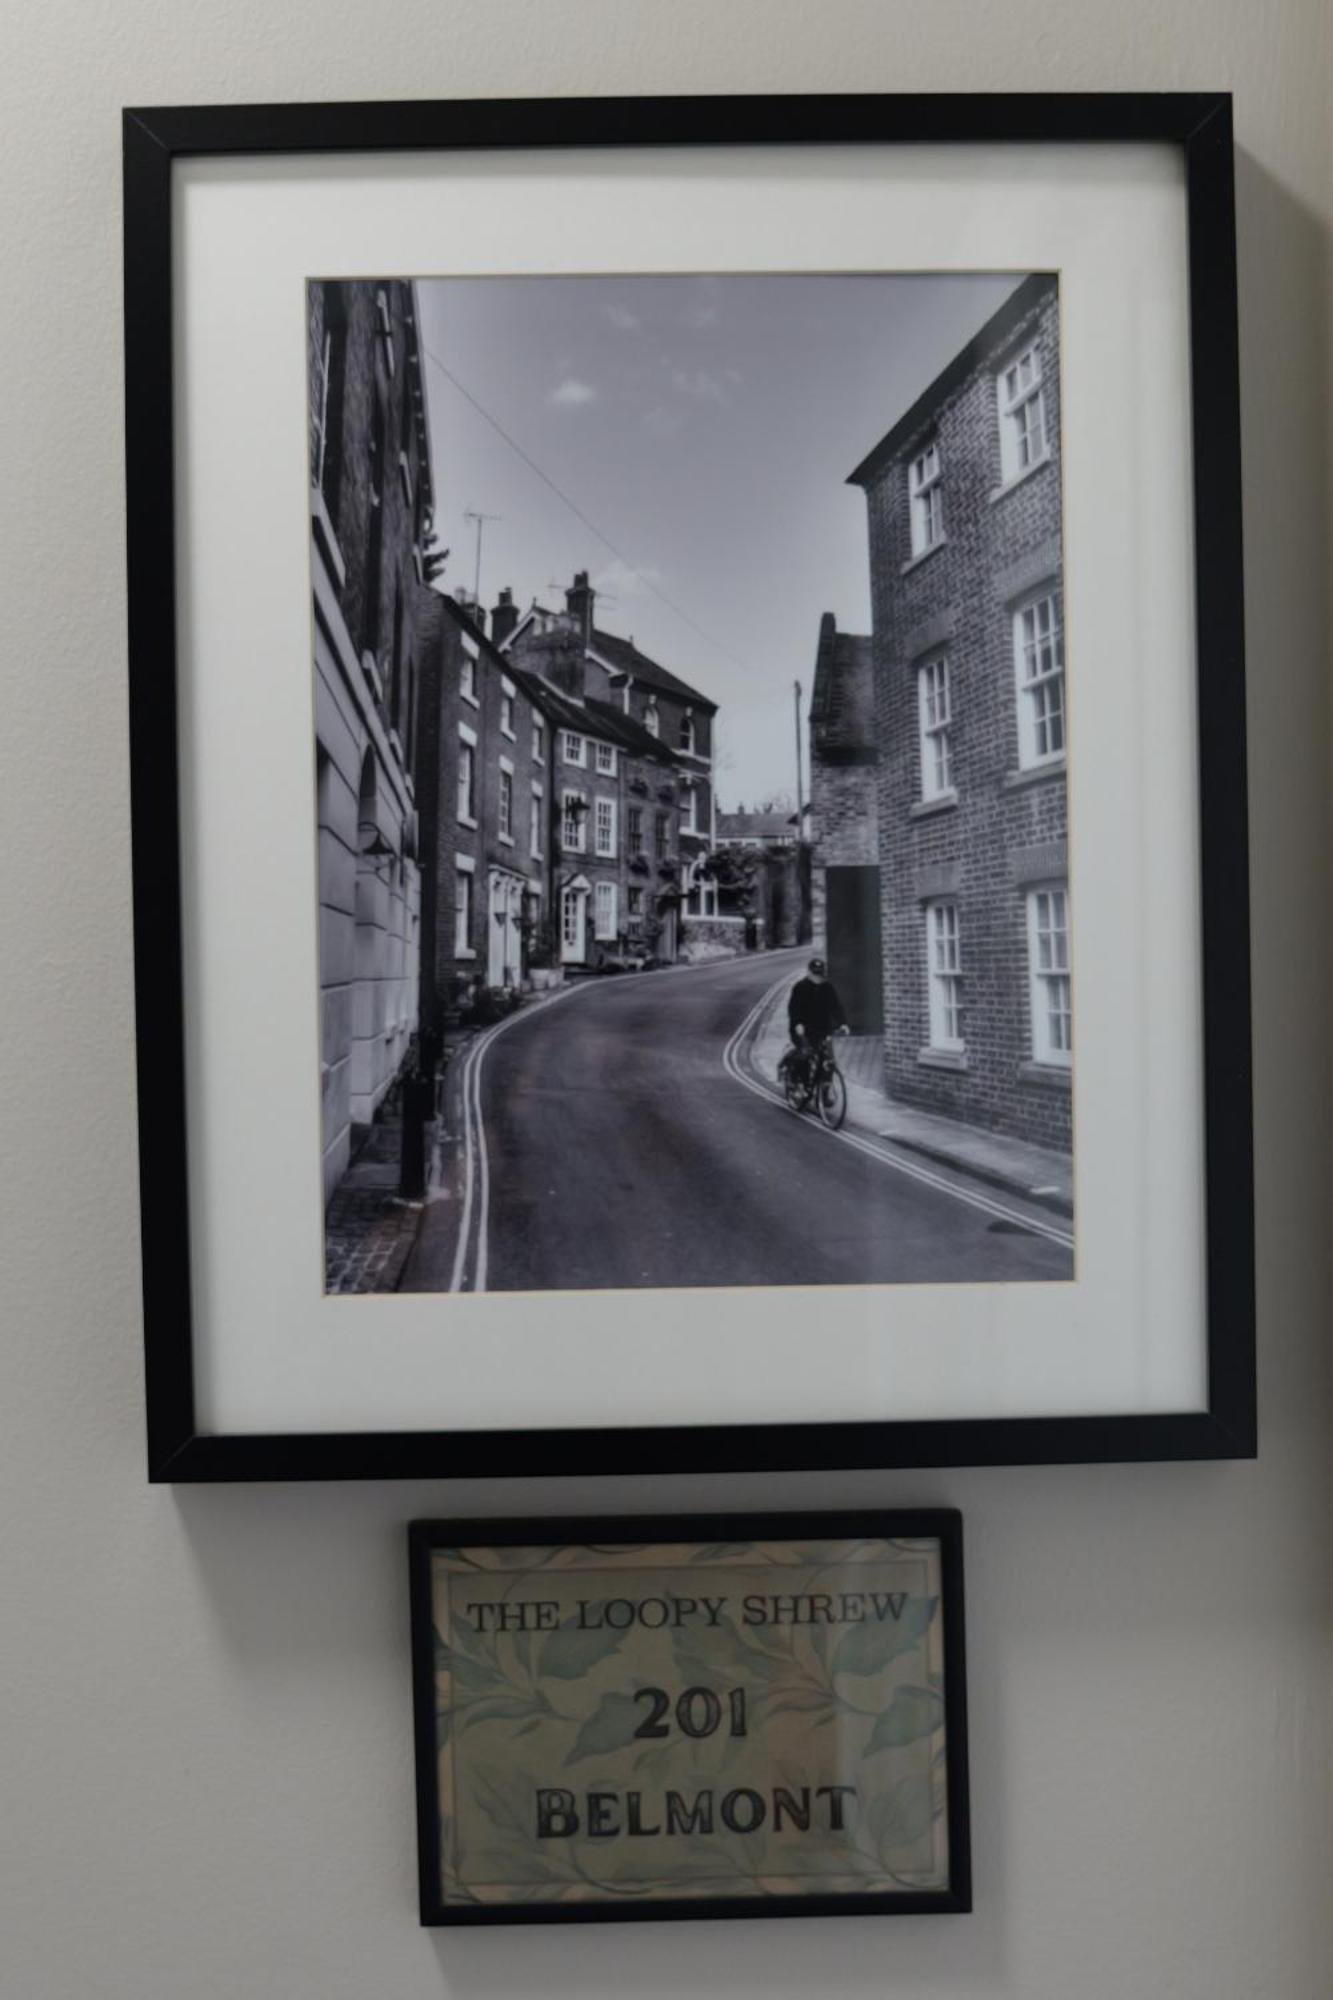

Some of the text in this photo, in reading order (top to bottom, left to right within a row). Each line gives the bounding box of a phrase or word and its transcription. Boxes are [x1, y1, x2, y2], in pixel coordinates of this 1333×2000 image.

[467, 1591, 909, 1634] THE LOOPY SHREW
[632, 1686, 747, 1739] 201
[535, 1785, 857, 1839] BELMONT
